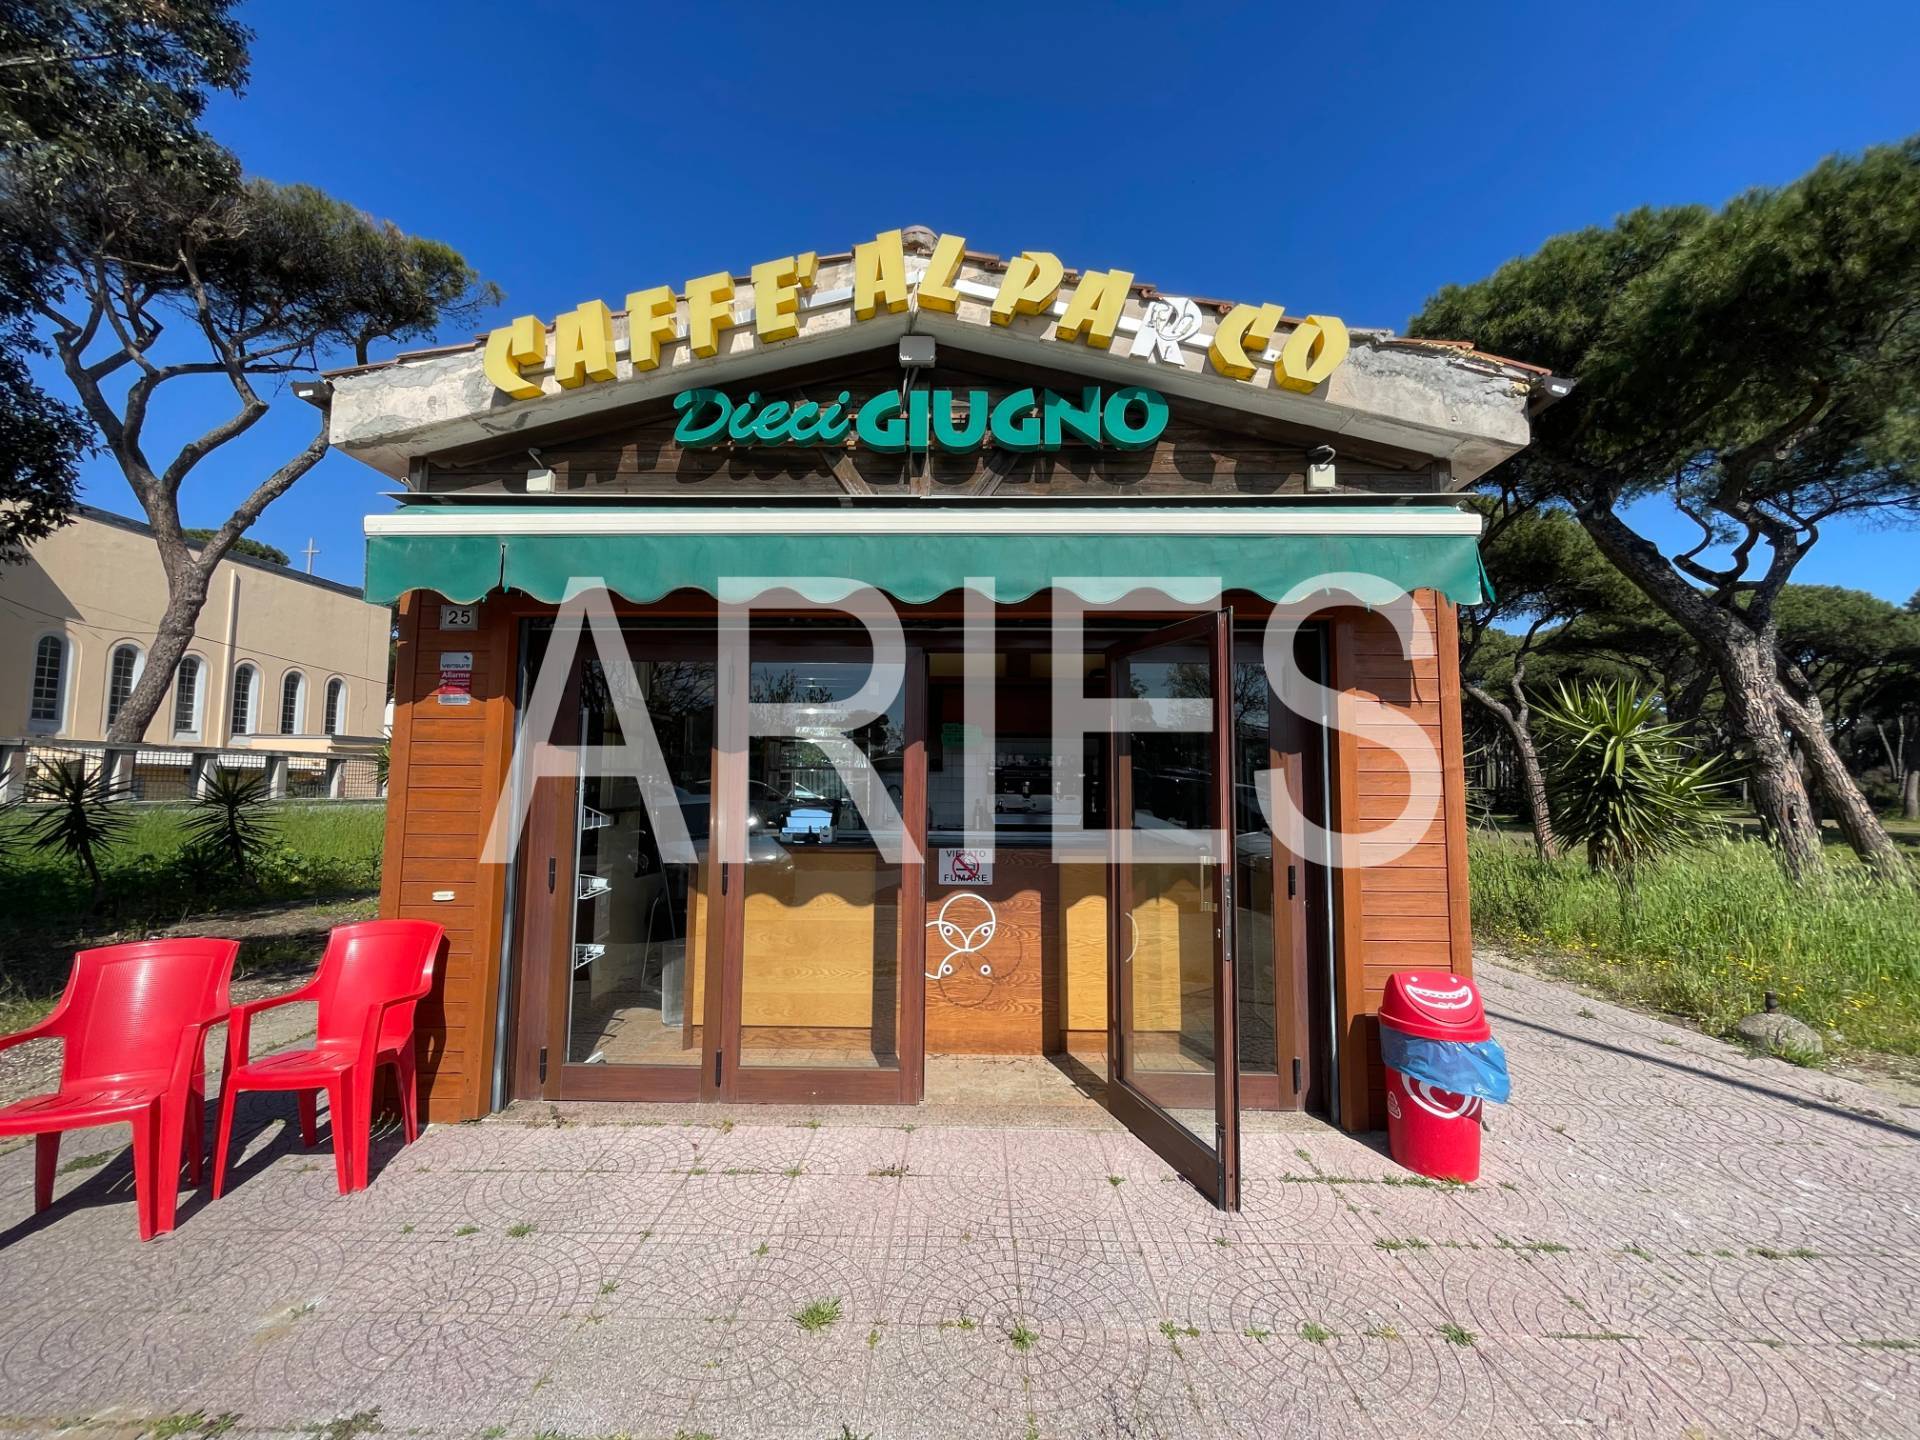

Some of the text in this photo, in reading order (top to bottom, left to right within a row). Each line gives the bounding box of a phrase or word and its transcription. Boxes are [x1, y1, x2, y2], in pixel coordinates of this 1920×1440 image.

[483, 228, 1350, 400] CAFFE' AL PARCO
[673, 385, 1170, 454] Dieci GIUGNO
[448, 610, 471, 625] 25
[944, 873, 988, 882] FUMARE
